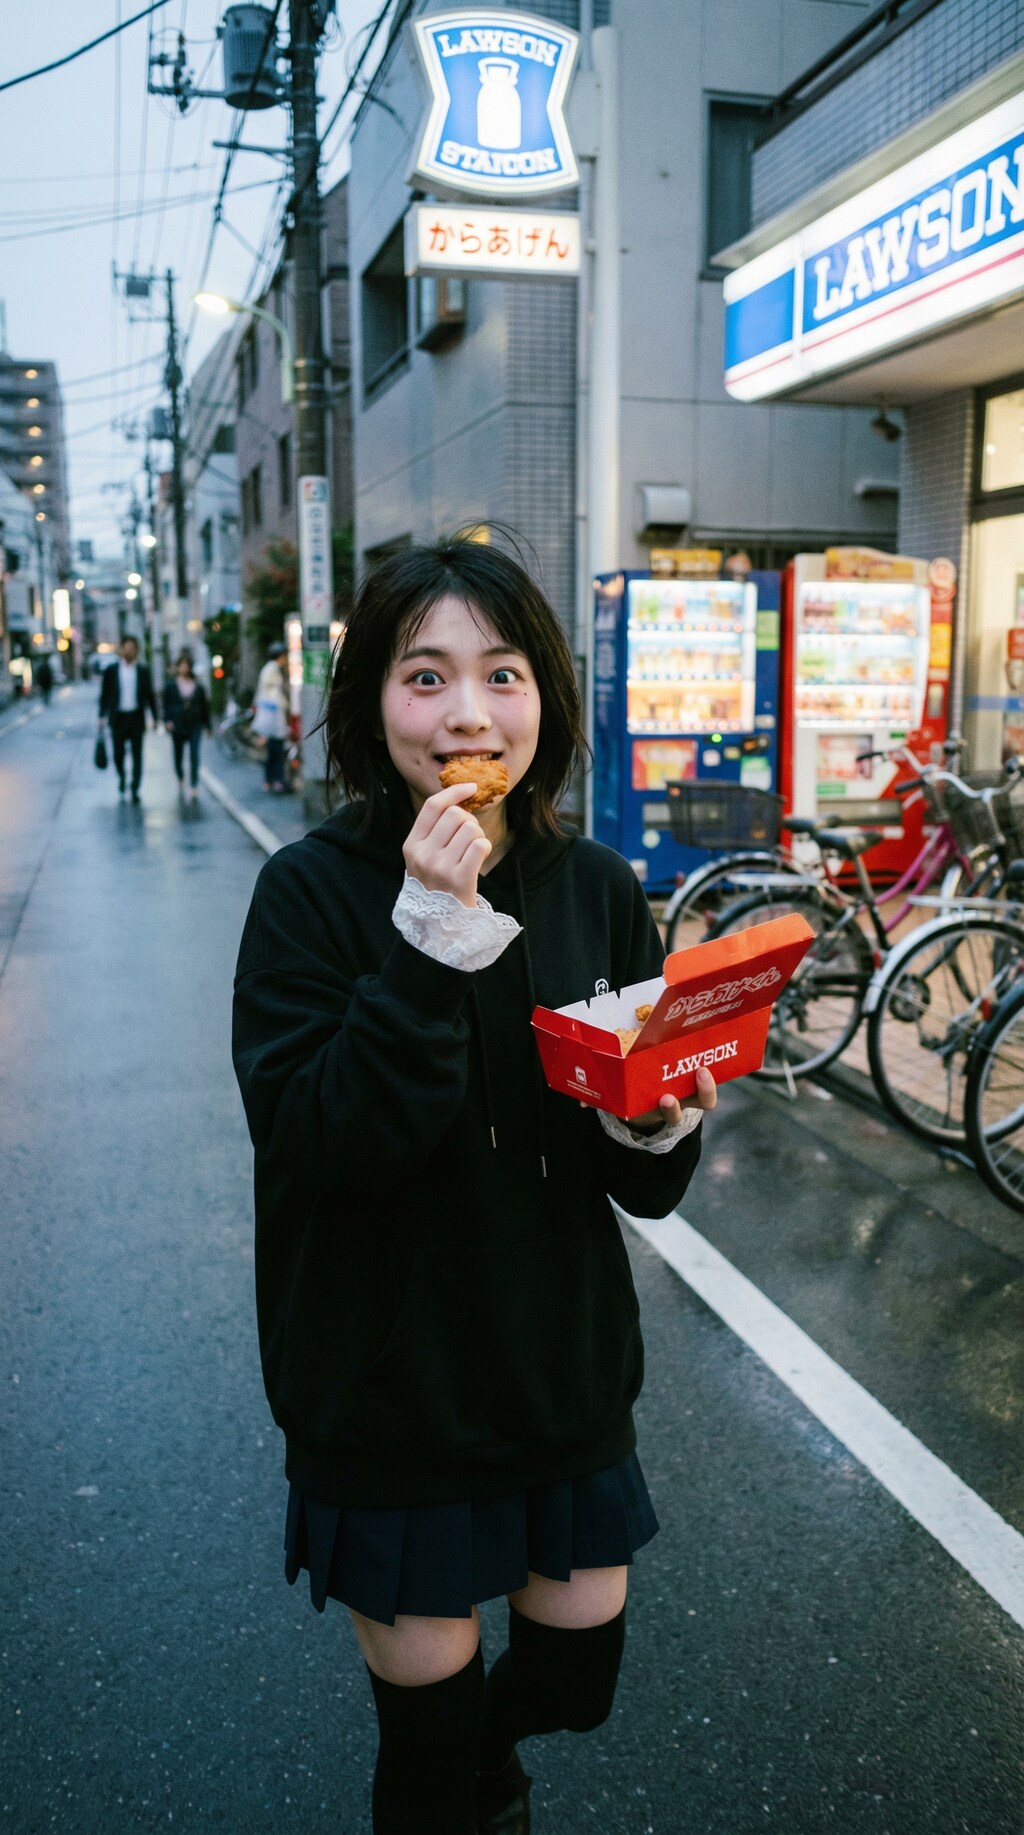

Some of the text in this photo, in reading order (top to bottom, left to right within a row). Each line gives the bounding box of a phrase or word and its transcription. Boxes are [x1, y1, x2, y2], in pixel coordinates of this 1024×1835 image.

[437, 29, 560, 67] LAWSON
[430, 222, 569, 258] からあげん
[813, 142, 1024, 321] LAWSON
[661, 1039, 738, 1081] LAWSON
